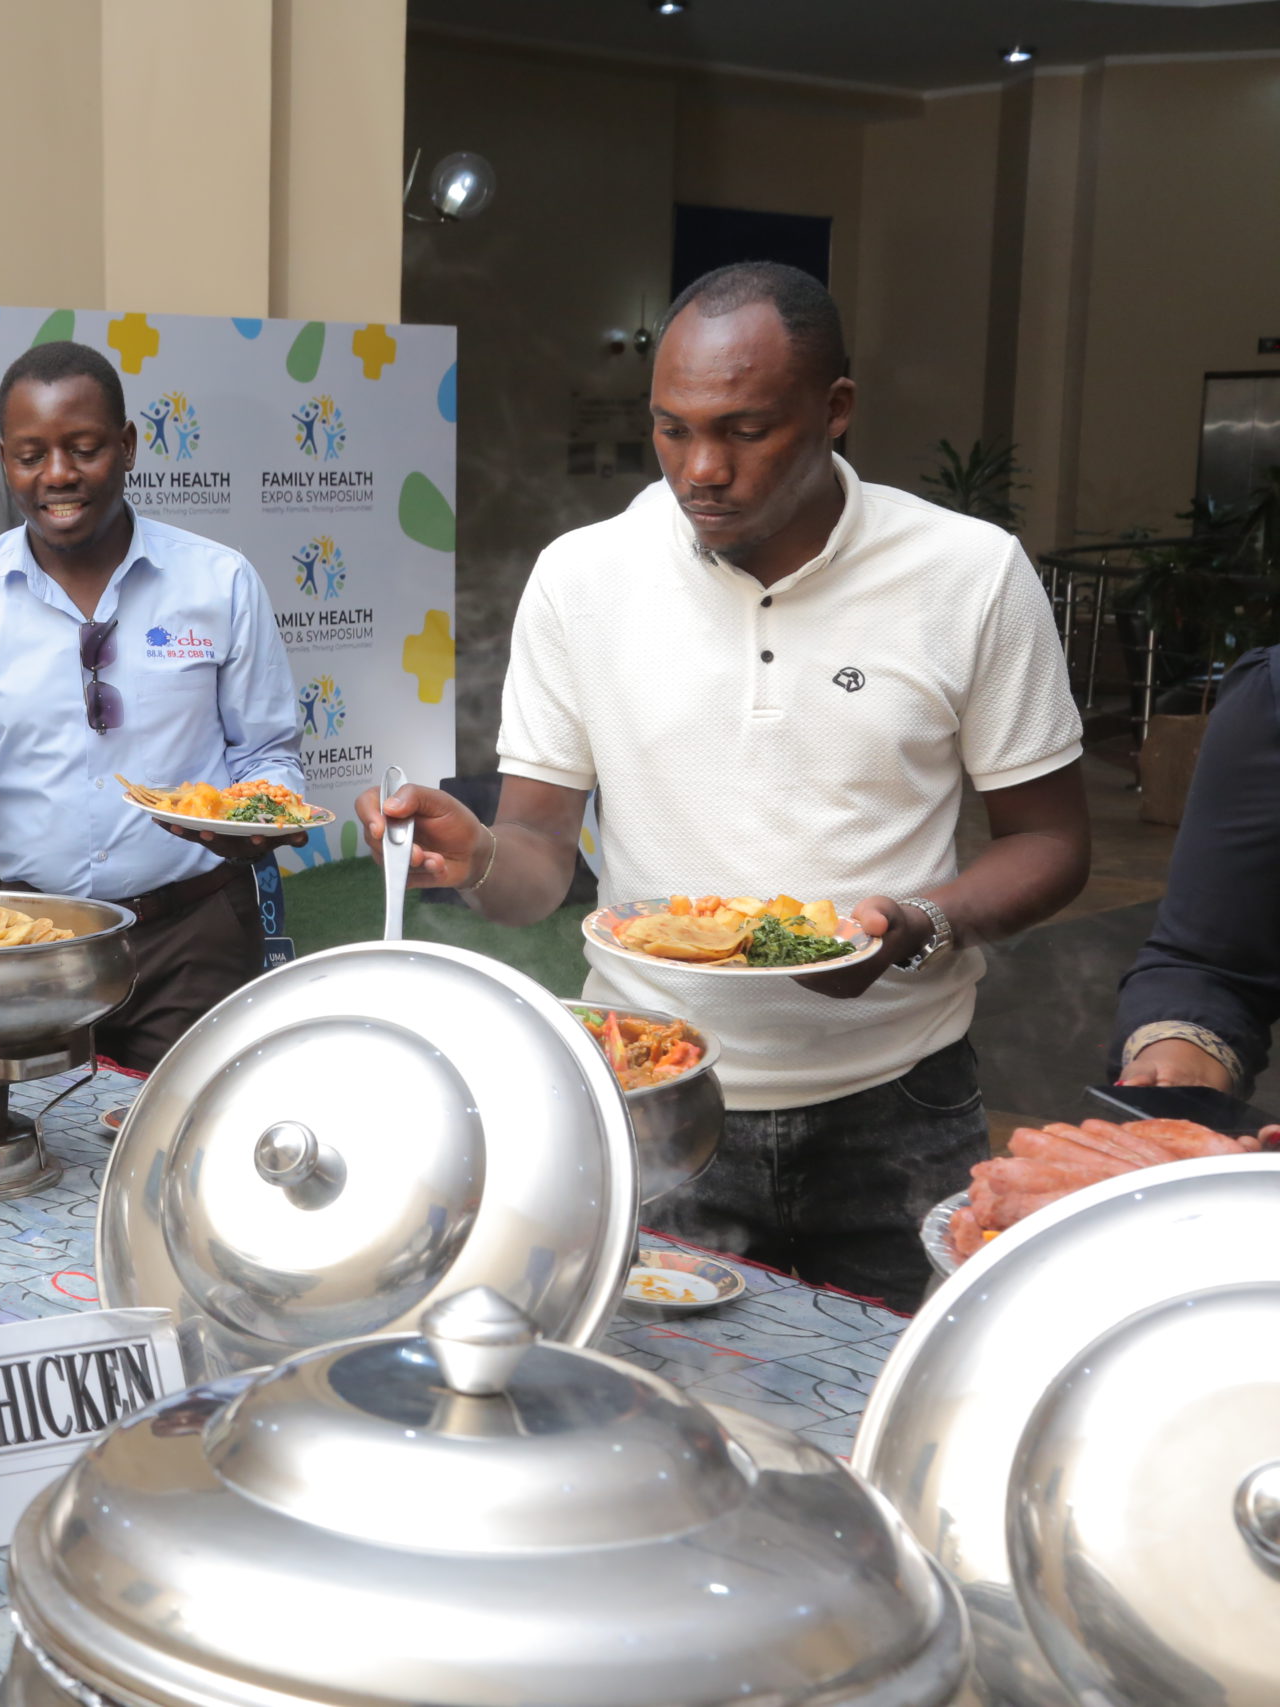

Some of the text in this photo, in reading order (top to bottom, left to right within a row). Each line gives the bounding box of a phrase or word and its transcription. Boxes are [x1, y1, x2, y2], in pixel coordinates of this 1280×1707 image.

[124, 472, 231, 488] MILY HEALTH
[262, 471, 373, 487] FAMILY HEALTH
[145, 492, 153, 505] &
[156, 491, 231, 504] SYMPOSIUM
[261, 489, 374, 503] EXPO & SYMPOSIUM
[274, 608, 373, 628] MILY HEALTH
[177, 629, 213, 646] cbs
[296, 631, 303, 643] &
[306, 627, 373, 642] SYMPOSIUM
[205, 650, 215, 659] FM
[319, 745, 373, 764] HEALTH
[306, 763, 373, 781] SYMPOSIUM
[269, 953, 287, 962] UMA
